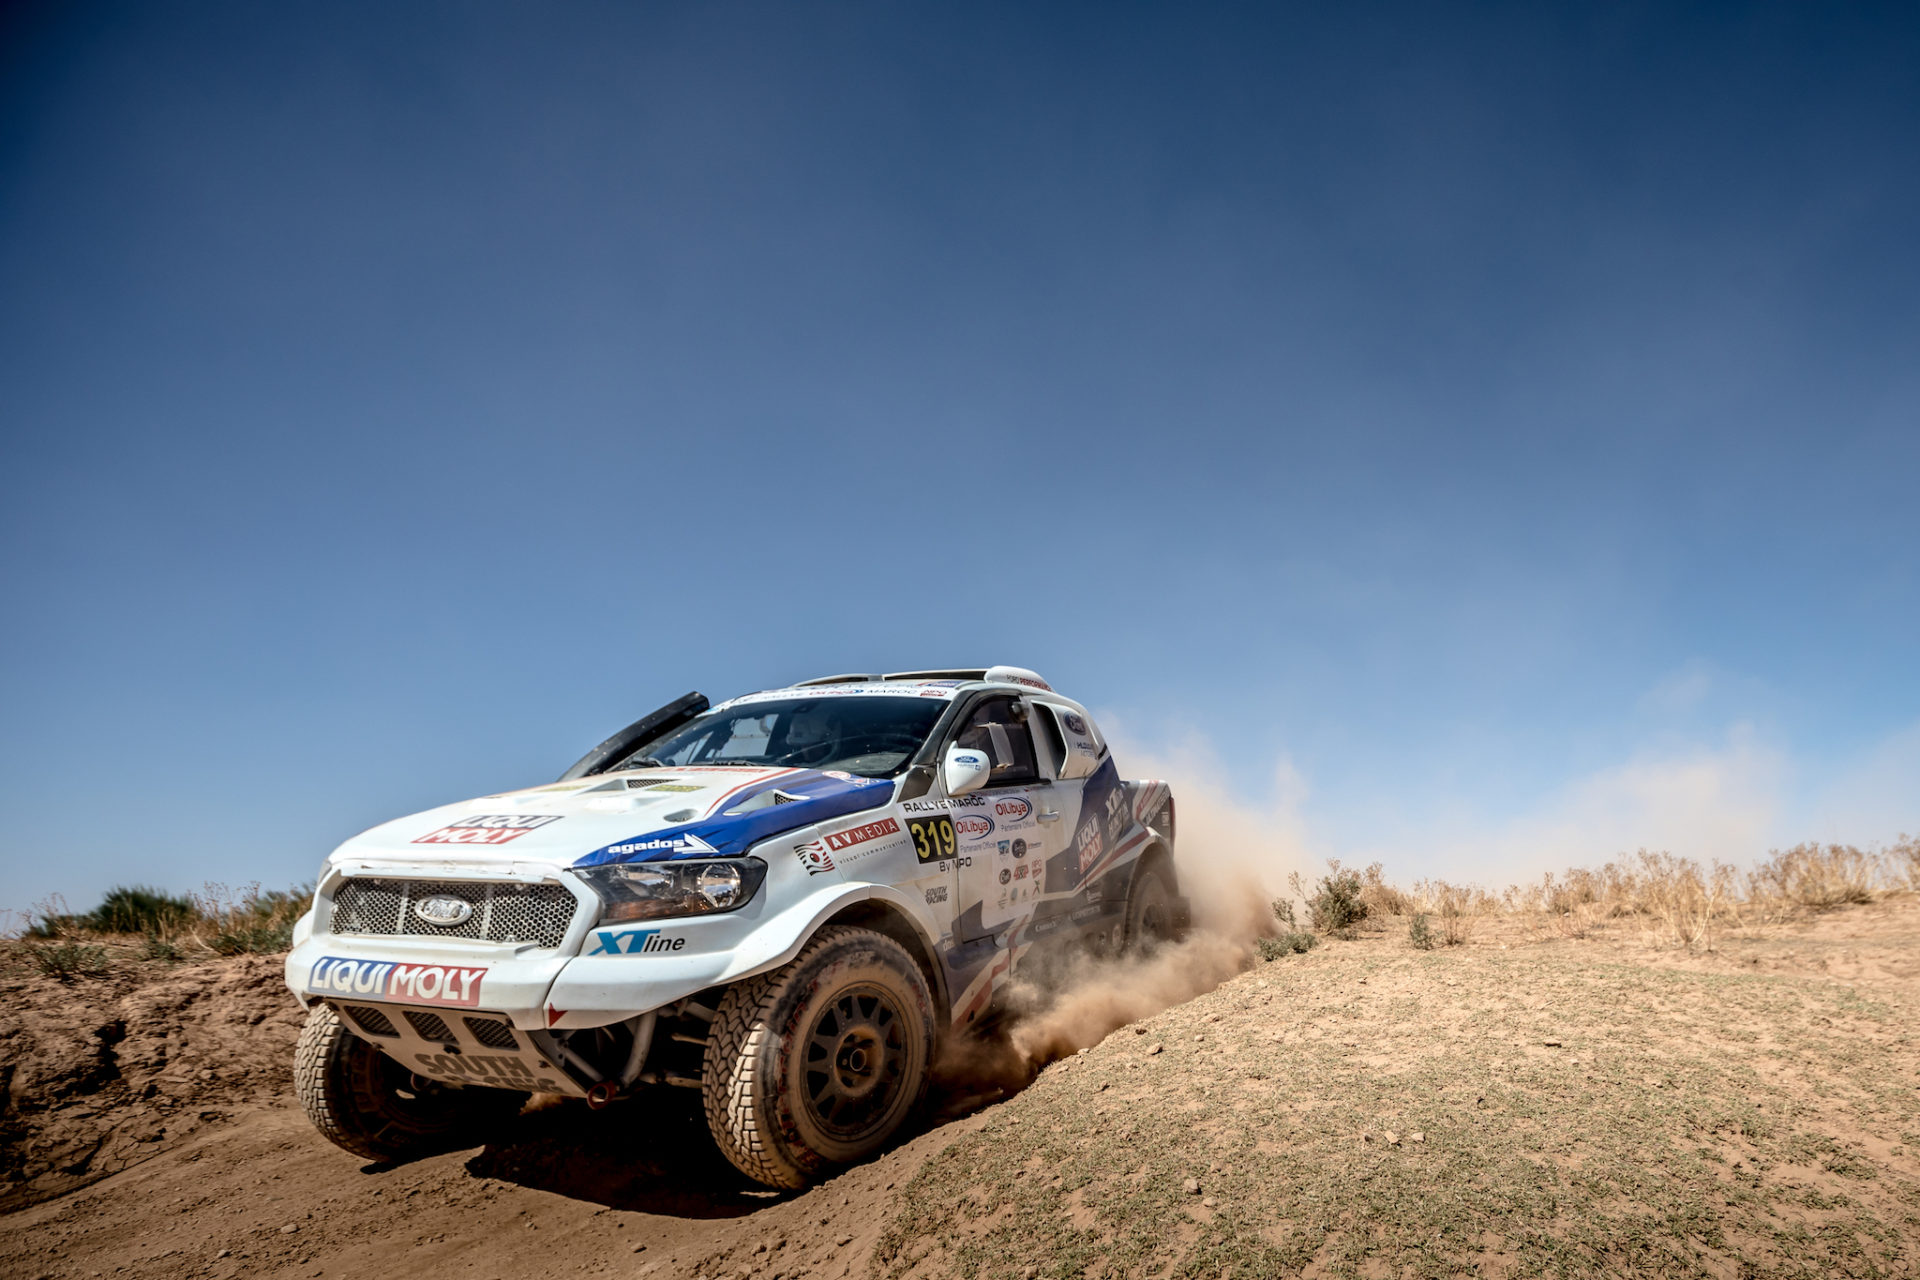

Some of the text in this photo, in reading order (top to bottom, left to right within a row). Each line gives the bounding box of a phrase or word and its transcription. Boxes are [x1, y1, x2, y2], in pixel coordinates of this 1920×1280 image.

[903, 797, 986, 813] RALLYE MAROC
[995, 803, 1028, 816] OiLibya
[450, 815, 557, 828] LIQUI
[955, 821, 989, 835] OiLibya
[418, 828, 526, 843] MOLY
[1078, 813, 1098, 847] LIQUI
[607, 839, 685, 854] agados
[911, 820, 955, 859] 319
[1080, 838, 1103, 873] MOLY
[939, 857, 972, 874] By NPO
[925, 886, 948, 898] SOUTH
[925, 894, 949, 906] RACING
[311, 958, 486, 1001] LIQUI MOLY
[414, 1053, 535, 1078] SOUTH
